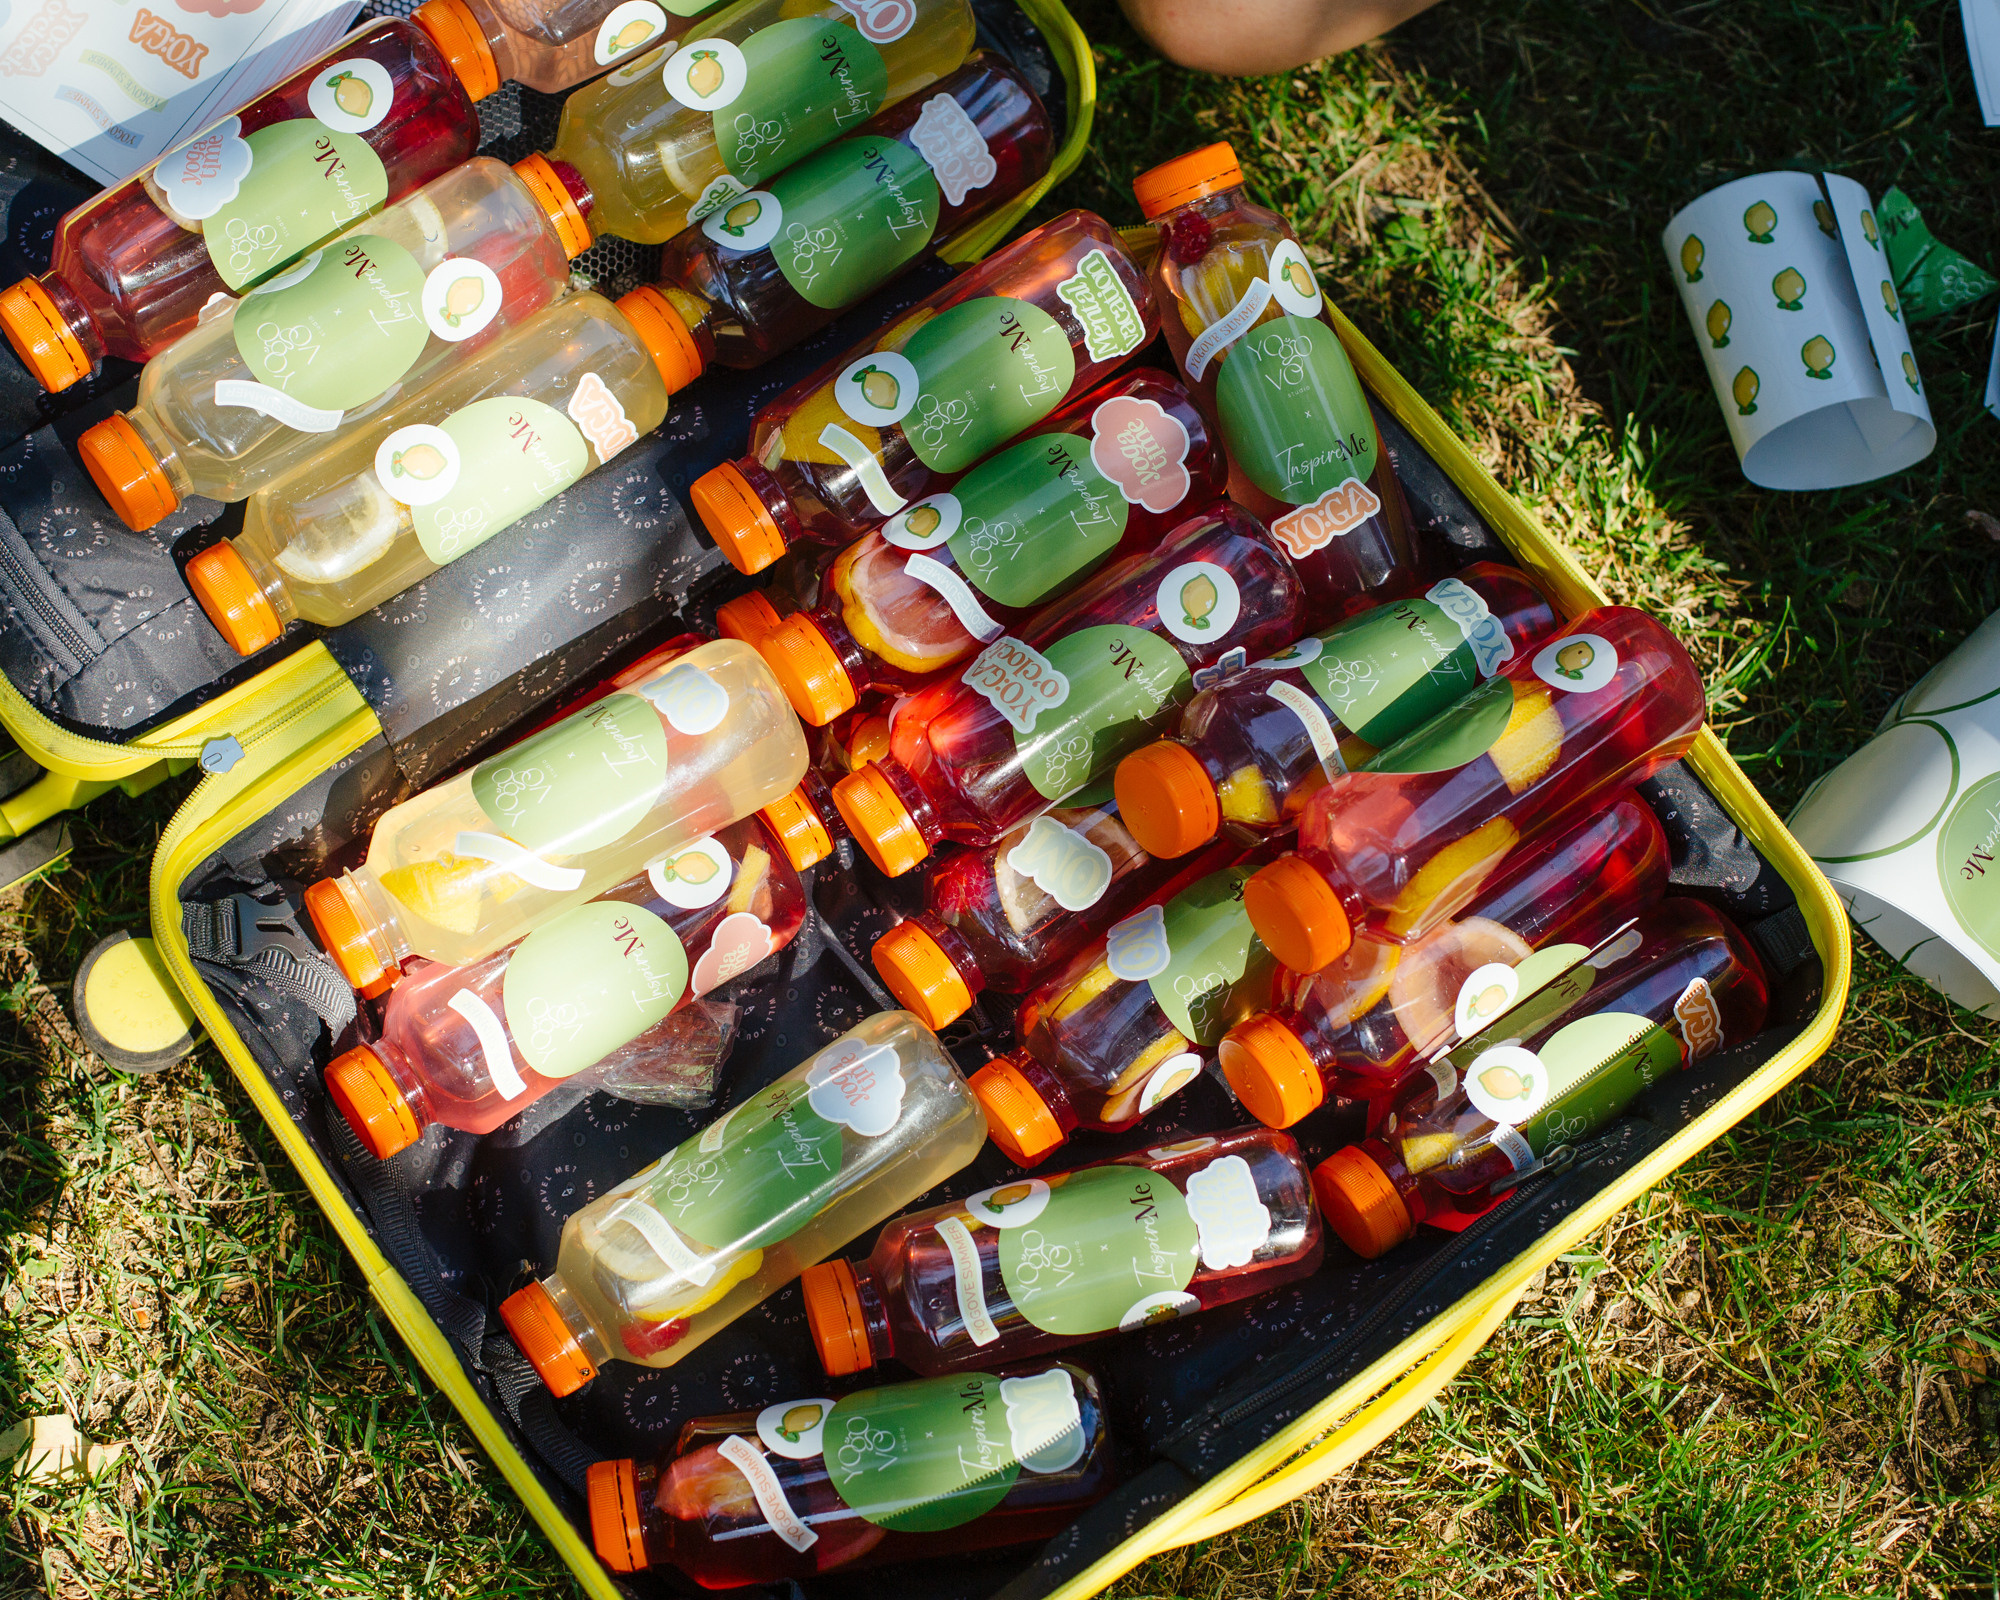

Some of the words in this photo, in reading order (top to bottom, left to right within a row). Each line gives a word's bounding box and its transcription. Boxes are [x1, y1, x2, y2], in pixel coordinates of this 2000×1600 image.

[134, 13, 205, 75] YO:GA
[181, 139, 208, 185] yoga
[200, 134, 224, 178] time
[1066, 281, 1119, 357] Mental
[1086, 257, 1139, 349] vacation
[1190, 330, 1223, 371] YOGOVE
[1221, 292, 1262, 337] SUMMER
[1119, 430, 1160, 486] yoga
[1128, 417, 1168, 471] time
[1280, 487, 1373, 549] YO:GA
[916, 561, 965, 605] SUMMER
[1434, 583, 1508, 668] YO:GA
[1278, 687, 1322, 732] SUMMER
[714, 949, 737, 987] oga
[1683, 991, 1716, 1058] O:GA
[830, 1061, 870, 1107] yoga
[840, 1052, 879, 1088] time
[948, 1225, 974, 1280] SUMMER
[958, 1279, 987, 1336] YOGOVE
[730, 1443, 776, 1502] SUMMER
[768, 1495, 804, 1542] YOGOVE
